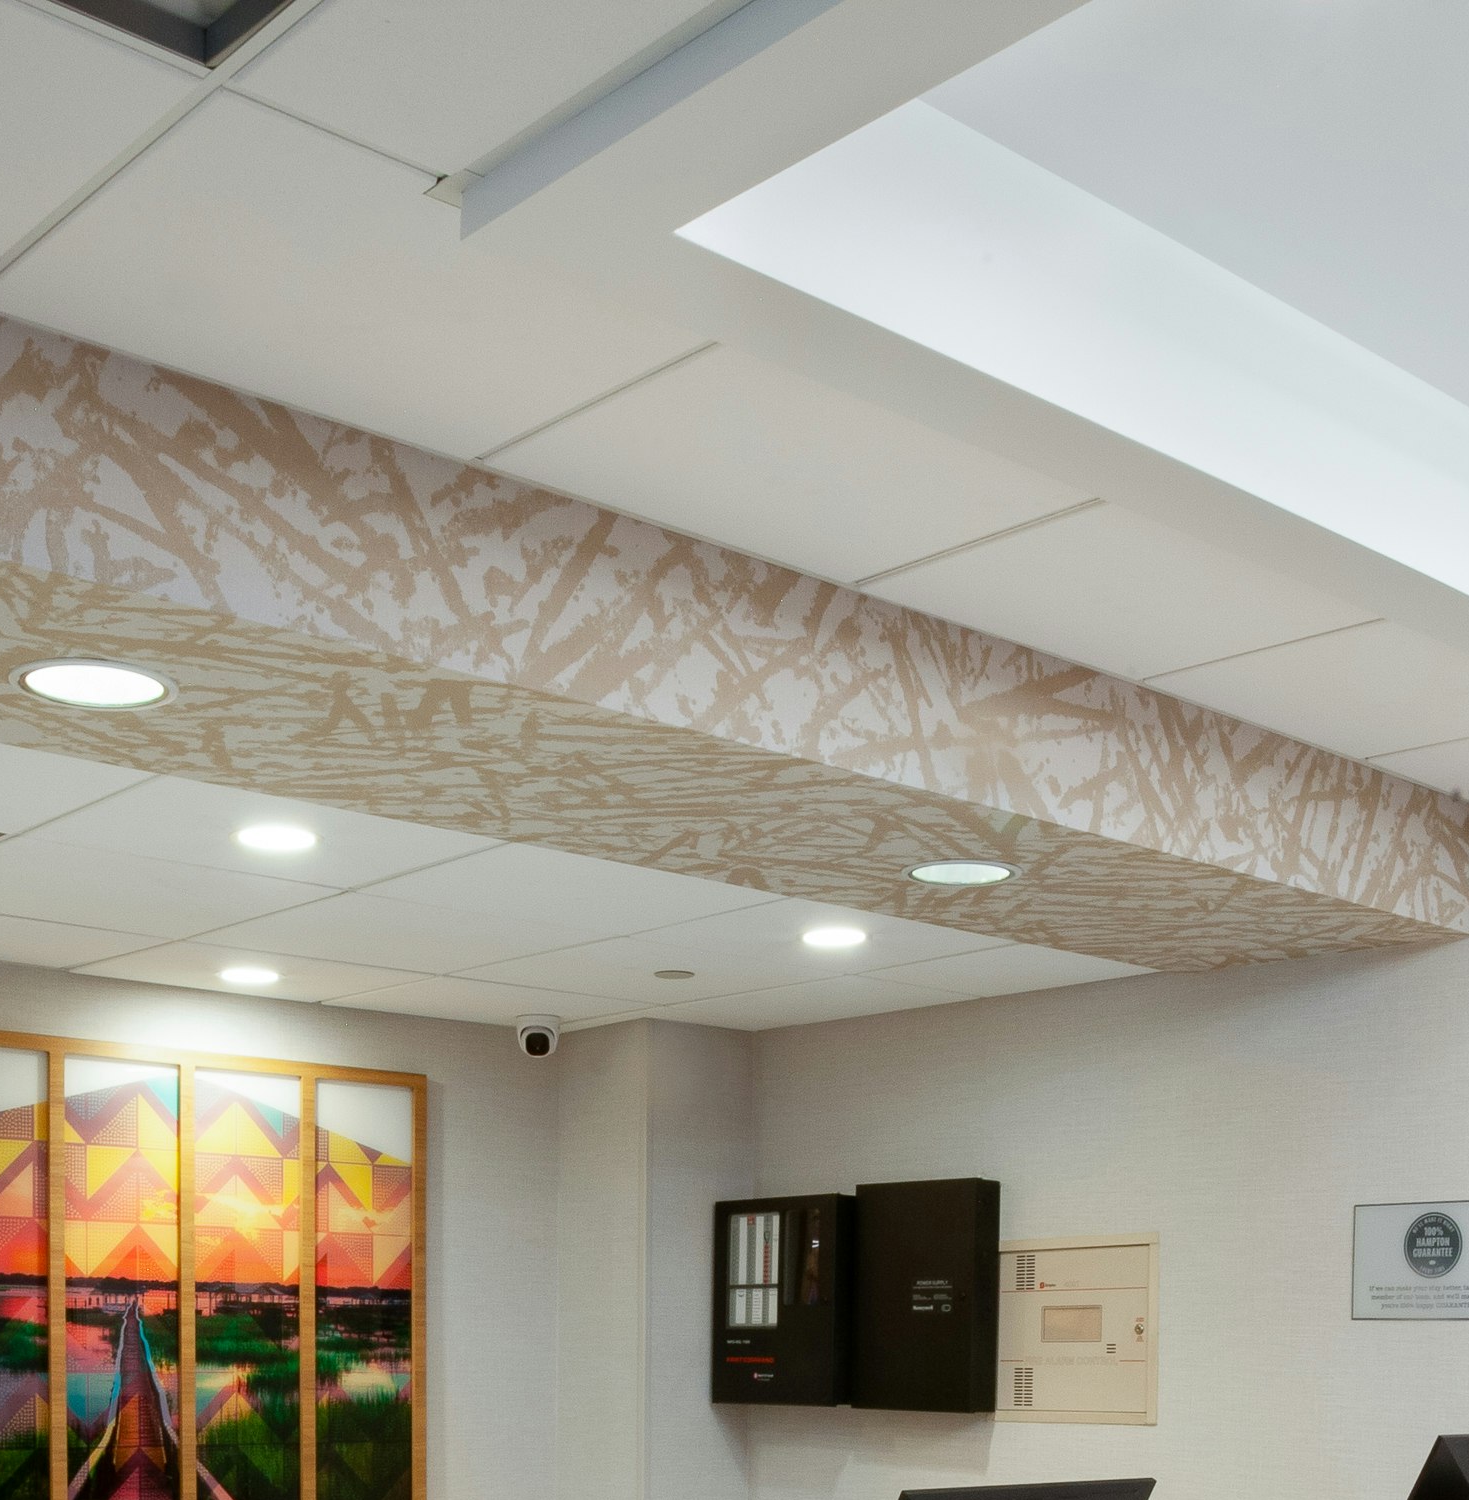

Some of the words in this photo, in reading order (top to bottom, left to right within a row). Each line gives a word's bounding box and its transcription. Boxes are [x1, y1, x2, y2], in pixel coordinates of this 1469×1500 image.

[1424, 1226, 1444, 1237] 100%
[1415, 1237, 1450, 1247] HAMPTON
[1412, 1247, 1453, 1258] GUARANTEE
